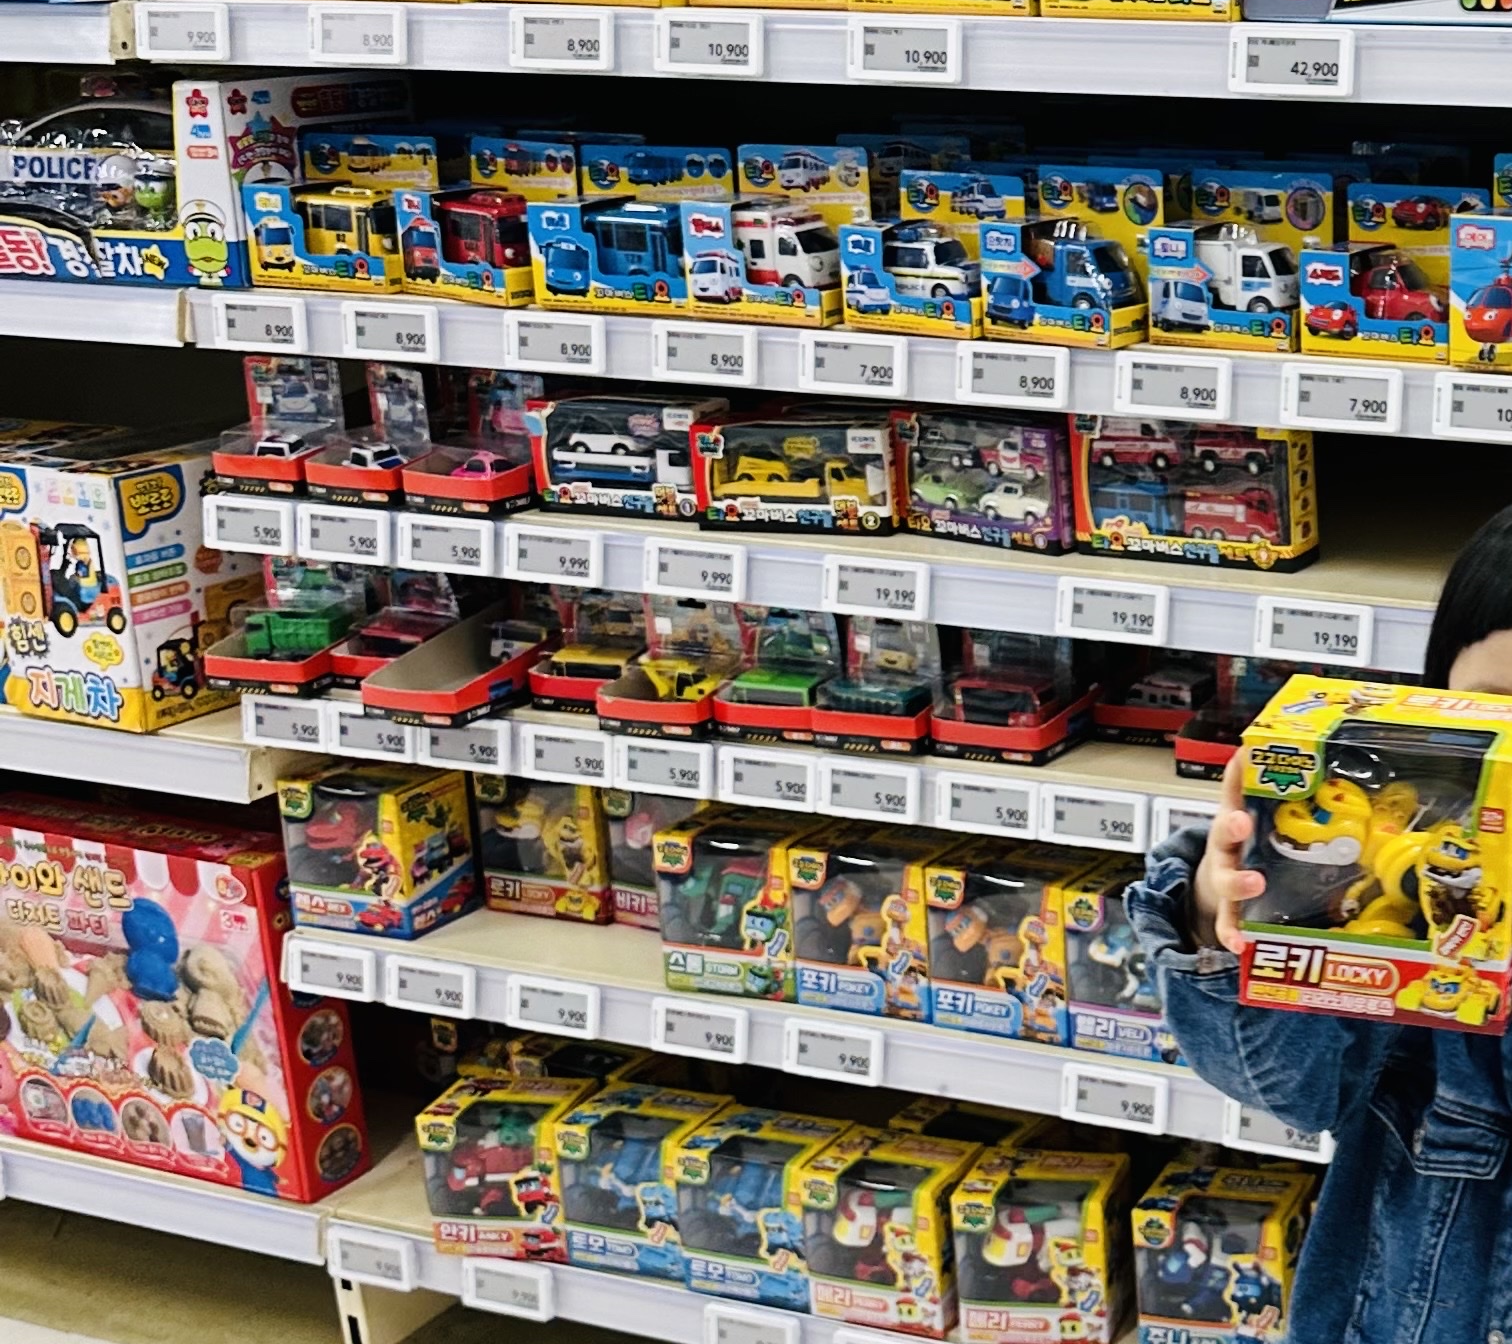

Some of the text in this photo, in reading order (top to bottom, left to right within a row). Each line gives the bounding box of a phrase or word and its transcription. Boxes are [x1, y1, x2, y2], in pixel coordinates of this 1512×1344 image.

[567, 37, 600, 53] 8,900
[707, 43, 750, 58] 10,900
[904, 48, 947, 66] 10,900
[1291, 61, 1339, 78] 42,900
[560, 342, 592, 358] 8,900
[710, 353, 744, 369] 8,900
[859, 364, 894, 382] 7,900
[1019, 375, 1055, 392] 8,900
[1179, 386, 1217, 404] 8,900
[1348, 397, 1388, 415] 7,900
[450, 545, 481, 561] 5,900
[559, 555, 590, 571] 9,990
[700, 568, 733, 585] 9,990
[875, 587, 916, 604] 19,190
[1112, 610, 1155, 629] 19,190
[1313, 630, 1358, 649] 19,190
[26, 667, 122, 721] 지게차
[775, 779, 807, 795] 5,900
[874, 791, 907, 808] 5,900
[995, 805, 1029, 823] 5,900
[1100, 818, 1134, 836] 5,900
[488, 877, 522, 901] 로키
[1250, 942, 1388, 987] 로키 LOCKY
[802, 969, 838, 994] 포키
[936, 989, 975, 1015] 포키
[1121, 1100, 1154, 1118] 9,900
